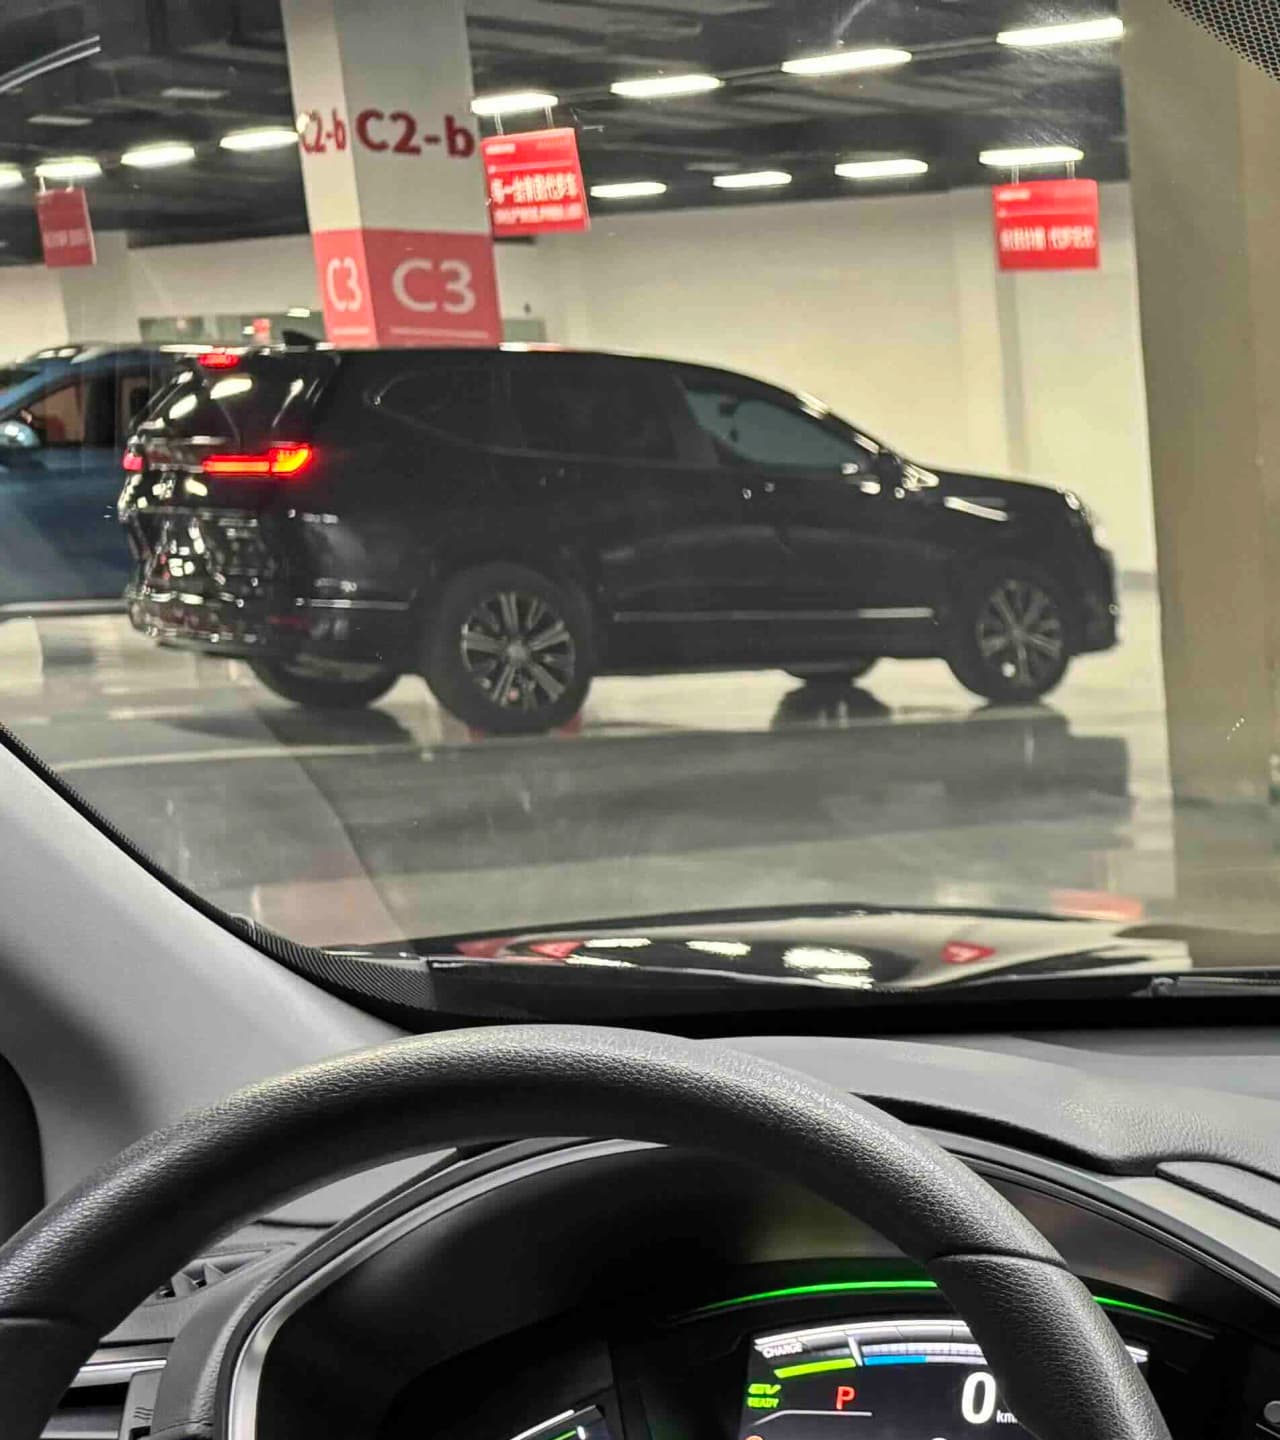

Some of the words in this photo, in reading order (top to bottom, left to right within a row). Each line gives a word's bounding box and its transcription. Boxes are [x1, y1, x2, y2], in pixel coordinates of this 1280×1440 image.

[355, 109, 475, 158] C2-b
[326, 257, 363, 312] C3
[391, 257, 476, 314] C3
[836, 1386, 856, 1411] P
